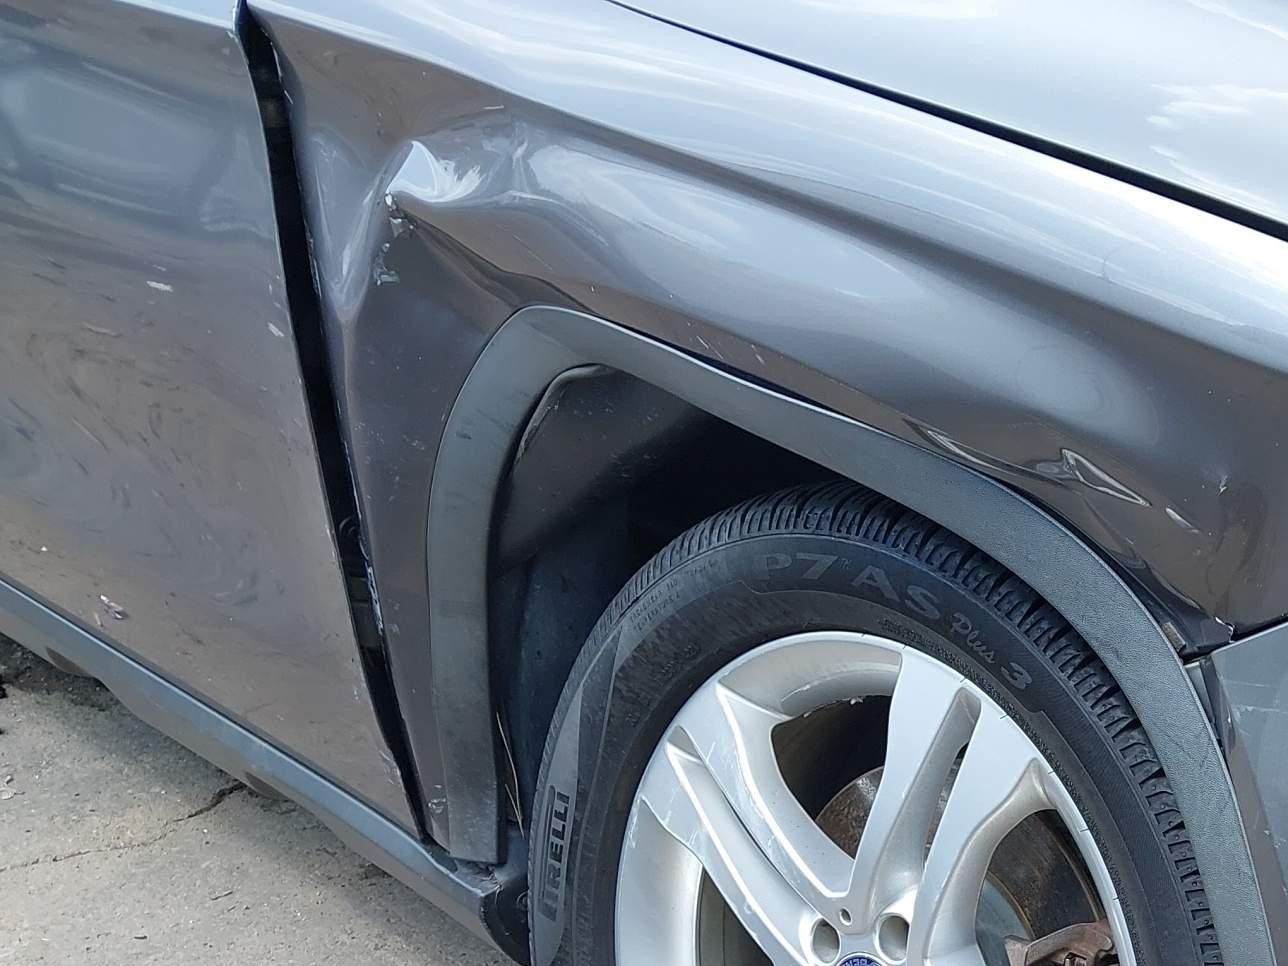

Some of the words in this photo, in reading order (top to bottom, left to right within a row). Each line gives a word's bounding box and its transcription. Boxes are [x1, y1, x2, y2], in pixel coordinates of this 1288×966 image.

[750, 551, 840, 581] P7
[850, 564, 941, 621] AS
[950, 611, 996, 664] Plus
[1001, 661, 1033, 690] 3
[538, 785, 571, 922] PIRELLI
